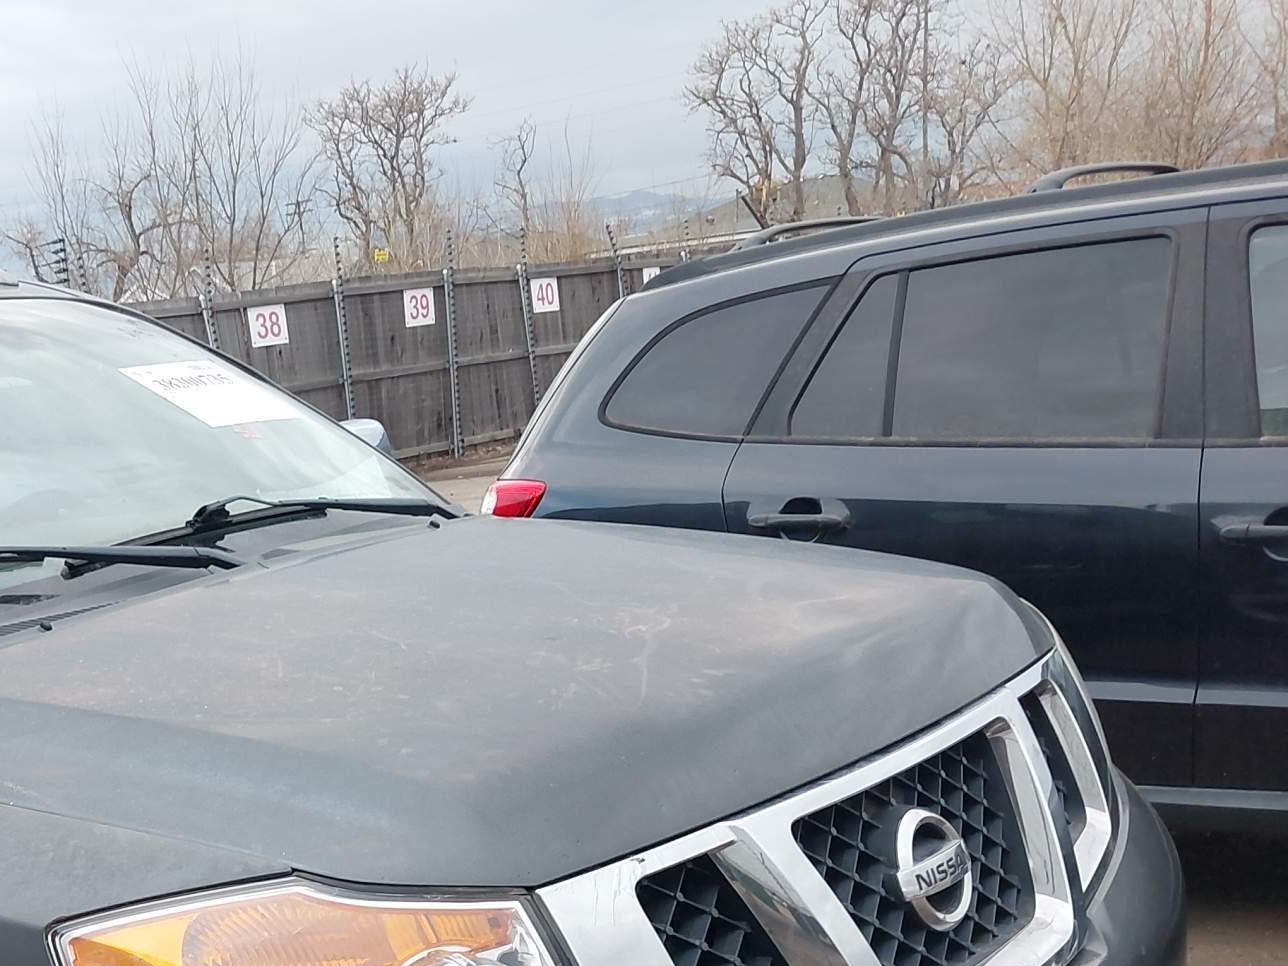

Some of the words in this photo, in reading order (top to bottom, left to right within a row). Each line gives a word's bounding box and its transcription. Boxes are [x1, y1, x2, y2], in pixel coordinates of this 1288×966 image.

[409, 294, 430, 319] 39
[536, 282, 555, 306] 40
[255, 311, 282, 340] 38
[915, 853, 967, 891] NISSA
